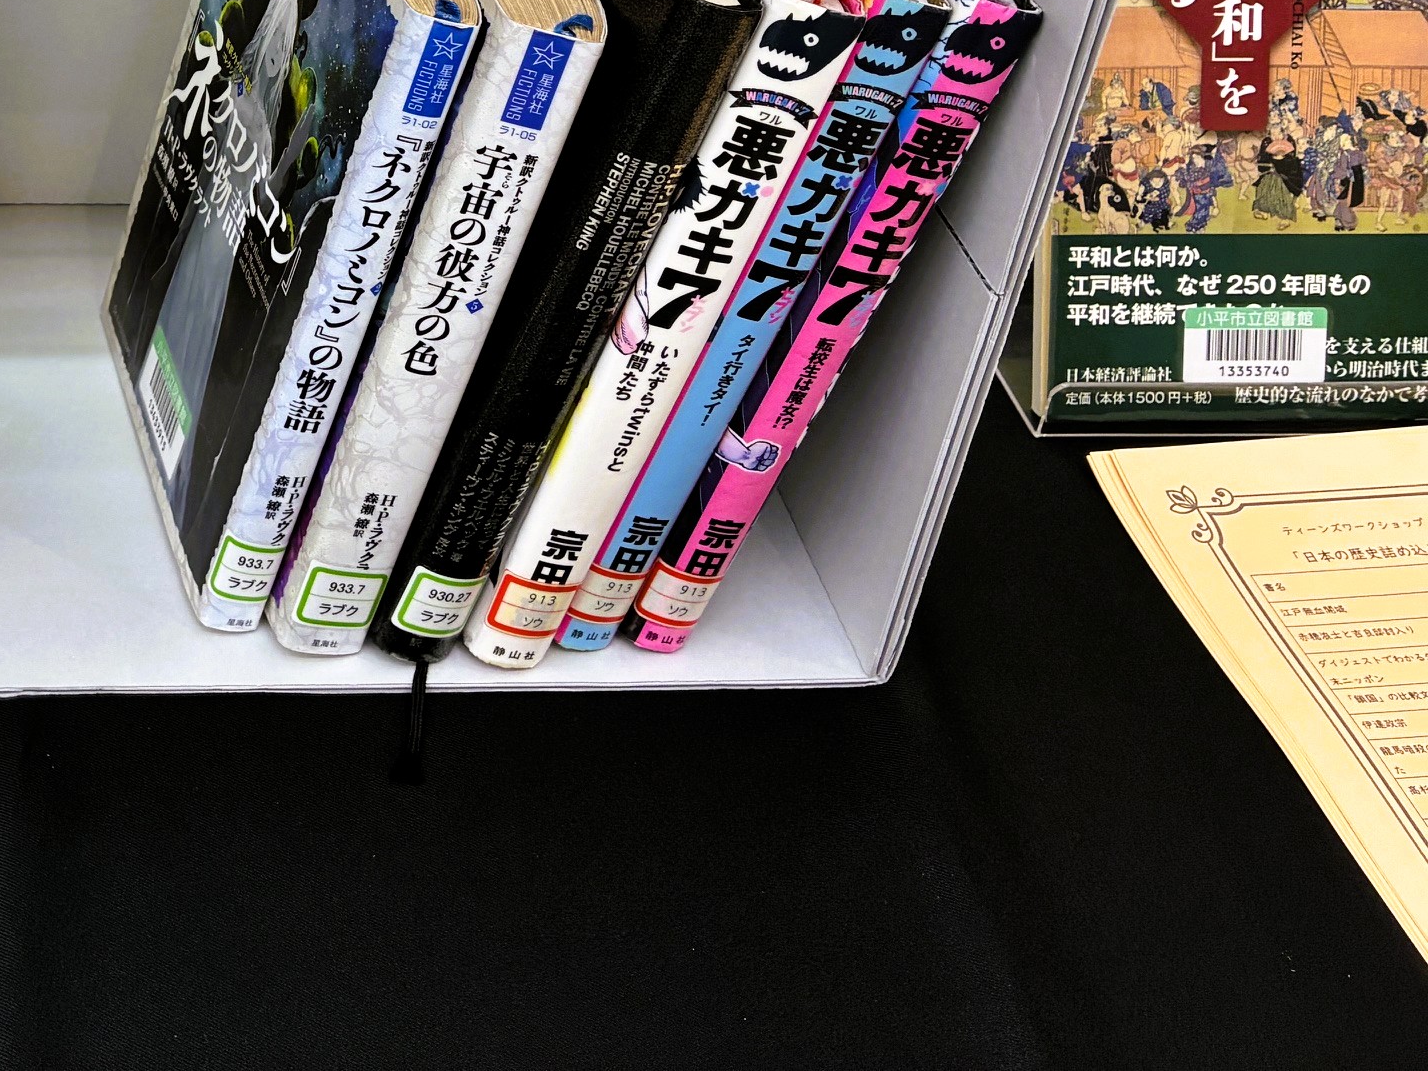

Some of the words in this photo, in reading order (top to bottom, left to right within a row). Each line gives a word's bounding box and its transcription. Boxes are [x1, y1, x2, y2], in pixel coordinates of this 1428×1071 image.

[408, 60, 438, 112] FICTIONS
[430, 64, 454, 104] 星海社
[506, 68, 538, 121] FICTIONS
[527, 73, 555, 116] 星海社
[759, 111, 782, 125] ワル
[855, 105, 877, 120] ワル
[940, 114, 963, 126] ワル
[401, 115, 438, 129] ラ1-02
[499, 125, 538, 142] ラ1-05
[593, 152, 631, 217] STEPHEN
[604, 157, 641, 224] INTRODUCTION
[622, 161, 657, 214] MICHEL
[641, 164, 671, 221] CONTRE
[647, 115, 795, 329] 悪ガキ7
[736, 109, 890, 322] 悪ガキ7
[816, 117, 973, 326] 悪ガキ7
[473, 154, 539, 297] 新訳クトゥルー神話コレクション
[626, 222, 641, 238] LE
[575, 217, 600, 251] KING
[400, 144, 518, 377] 宇宙の彼方の色
[575, 214, 632, 311] HOUELLEBECQ
[1068, 245, 1209, 268] 平和とは何か。
[283, 135, 423, 434] 『ネクロノミコン』の物語
[1197, 310, 1314, 327] 小平市立図書館
[616, 339, 656, 401] 仲間たち
[1066, 368, 1172, 382] 日本経済評論社
[1219, 366, 1290, 377] 13353740
[607, 345, 678, 472] いたずらtwinsと
[610, 515, 669, 573] 宗田
[686, 518, 746, 577] 宗田
[237, 556, 274, 569] 933.7
[530, 528, 589, 586] 宗田
[228, 577, 268, 591] ラブク
[328, 580, 365, 595] 933.7
[605, 582, 633, 594] 913
[680, 585, 707, 597] 913
[428, 589, 471, 603] 930.27
[528, 594, 557, 606] 913
[319, 603, 359, 617] ラブク
[594, 600, 614, 612] ソウ
[669, 604, 688, 617] ソウ
[226, 618, 252, 628] 星海社
[421, 610, 459, 625] ラブク
[523, 616, 543, 628] ソウ
[311, 638, 338, 648] 星海社
[571, 629, 610, 642] 静山社
[645, 630, 686, 645] 静山社
[493, 645, 535, 661] 静山社
